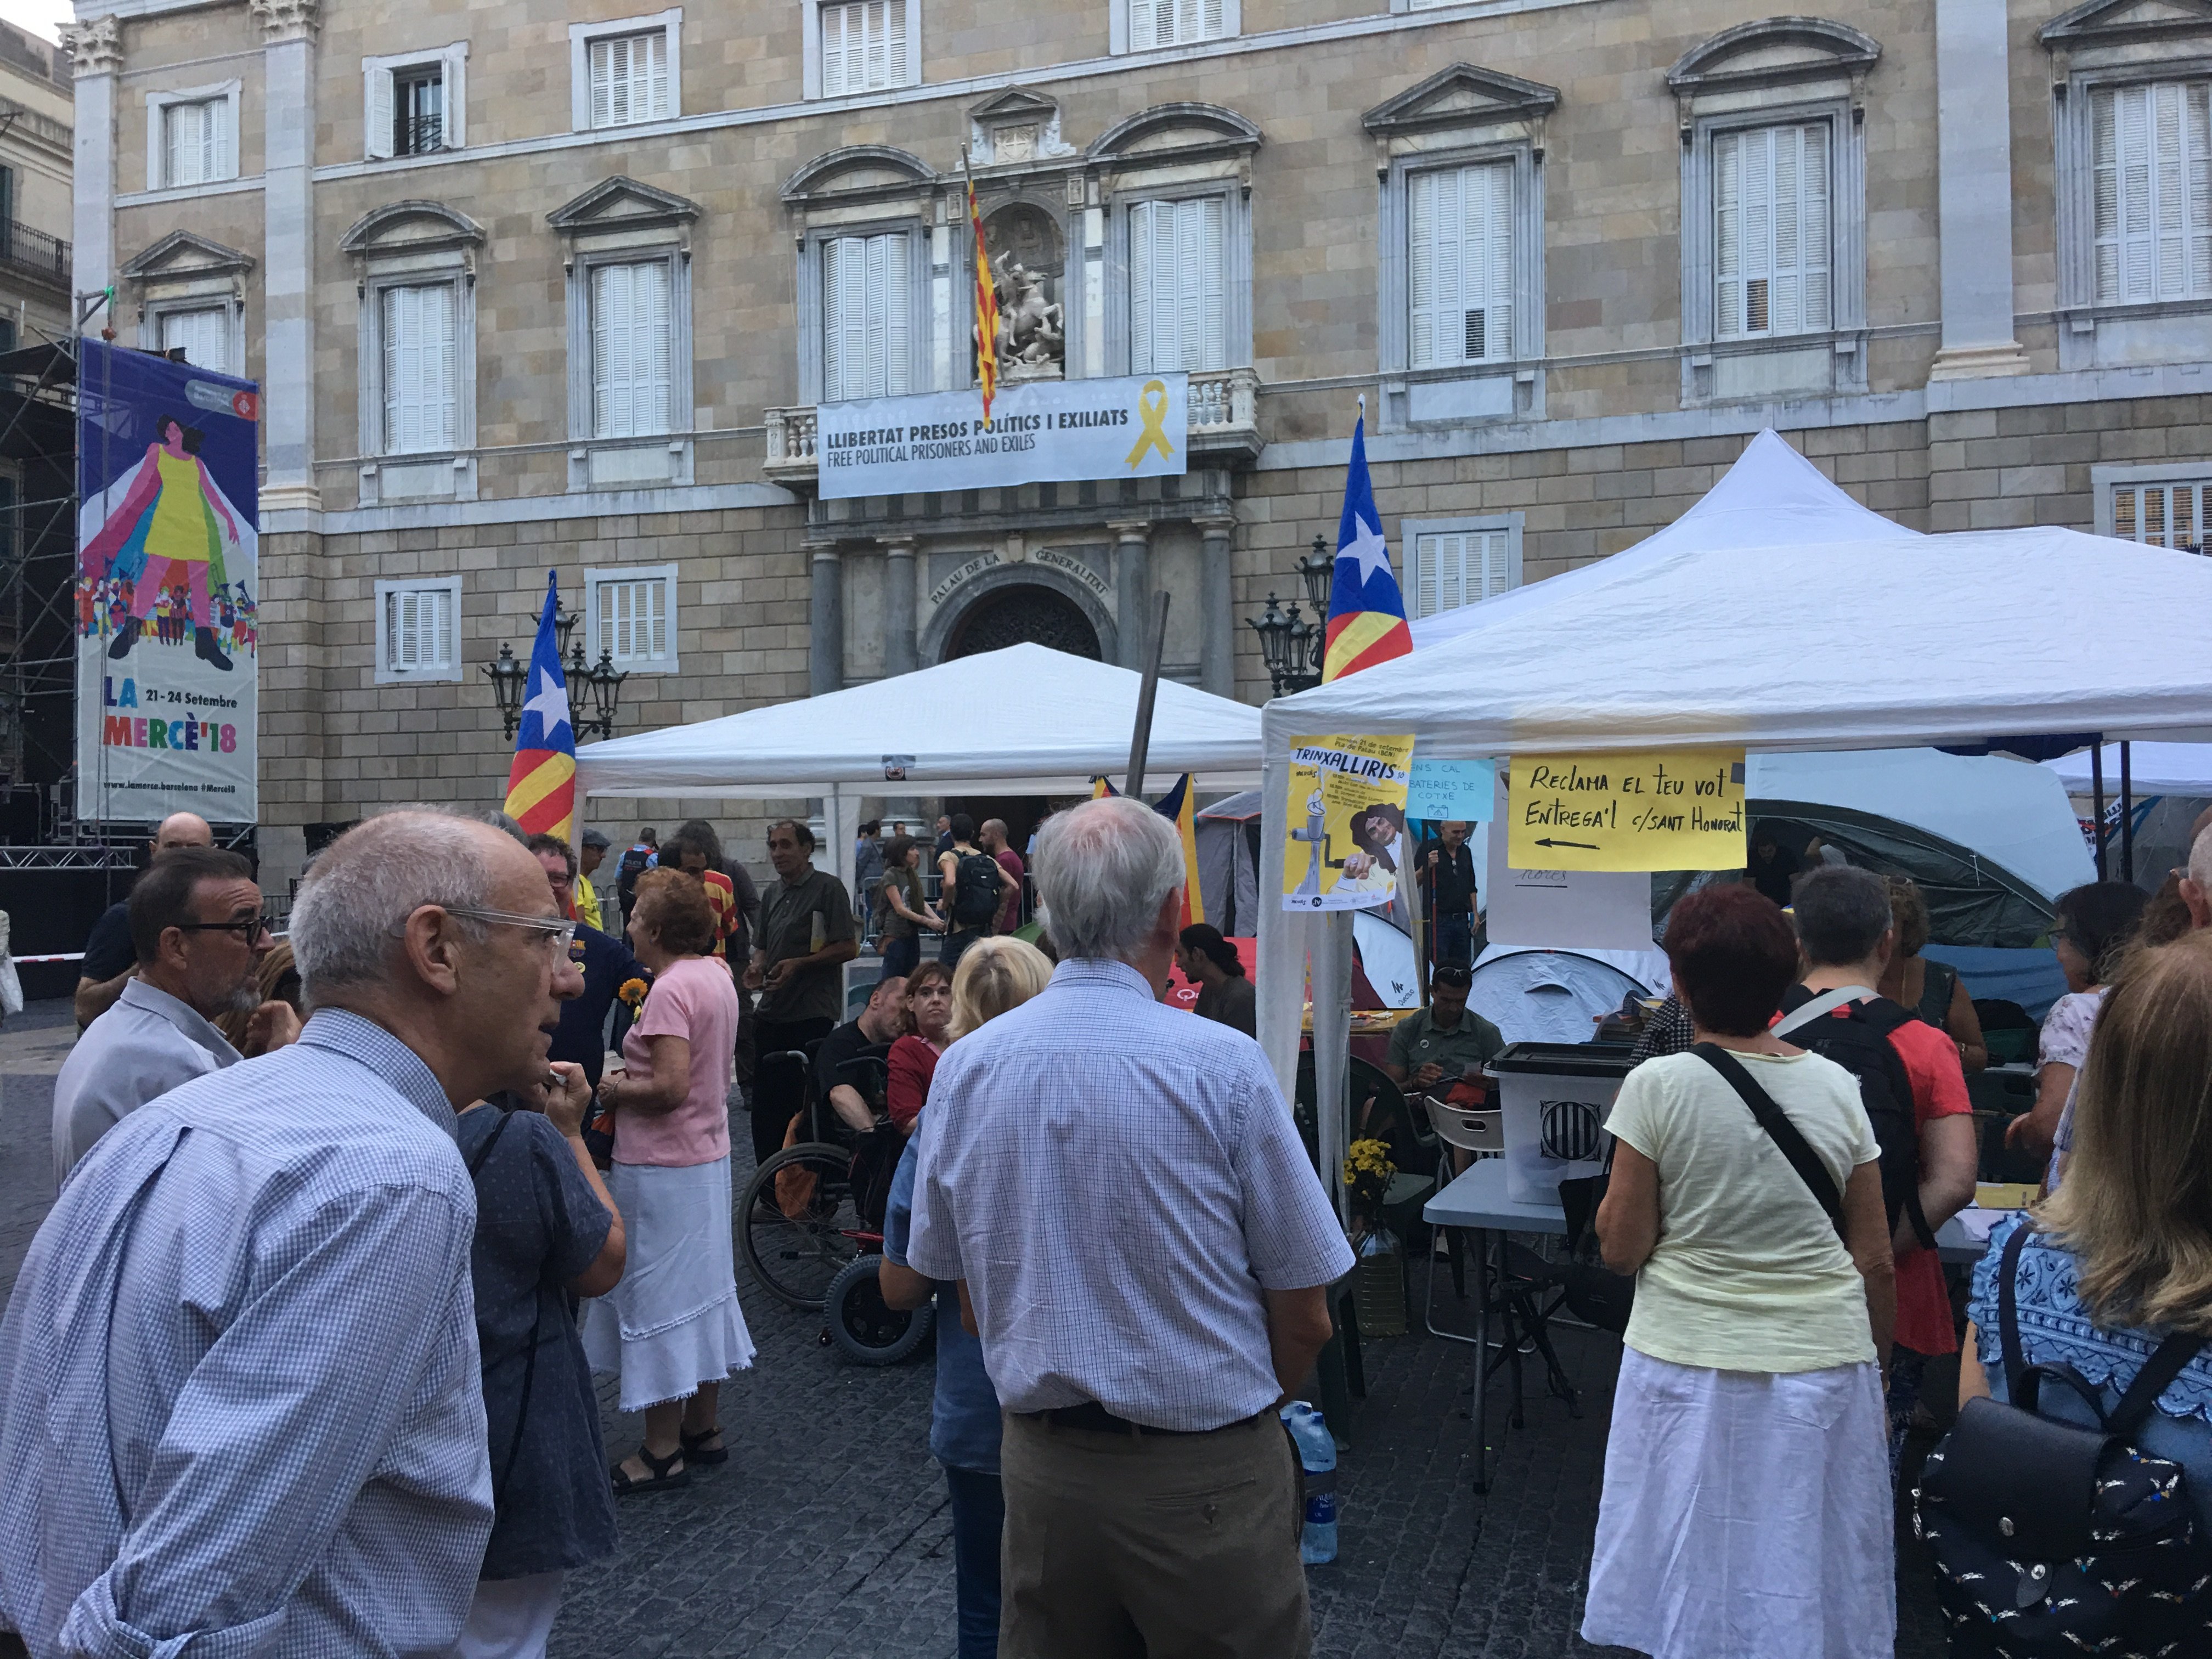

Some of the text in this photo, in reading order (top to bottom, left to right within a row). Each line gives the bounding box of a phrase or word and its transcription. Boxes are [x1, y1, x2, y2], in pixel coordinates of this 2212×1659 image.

[827, 409, 1128, 449] LLIBERTAT PRESOS POLÍTICS I EXILIATS
[827, 433, 1036, 467] FREE POLITICAL PRISONERS AND EXILES
[930, 551, 1108, 604] PALAU DE LA GENERALITAT
[104, 676, 138, 708] LA
[145, 689, 157, 702] 21
[167, 691, 182, 703] 24
[185, 692, 238, 708] Setembre
[103, 711, 236, 753] MERCÈ'18
[1296, 748, 1397, 779] TRINXALLIRIS
[1410, 764, 1460, 773] ENS CAL
[1530, 764, 1609, 792] RECLAMA
[1622, 776, 1645, 794] EL
[1409, 780, 1458, 791] BATERIES
[1463, 782, 1475, 791] DE
[1418, 792, 1454, 800] COTXE
[1692, 801, 1743, 833] HONORAT
